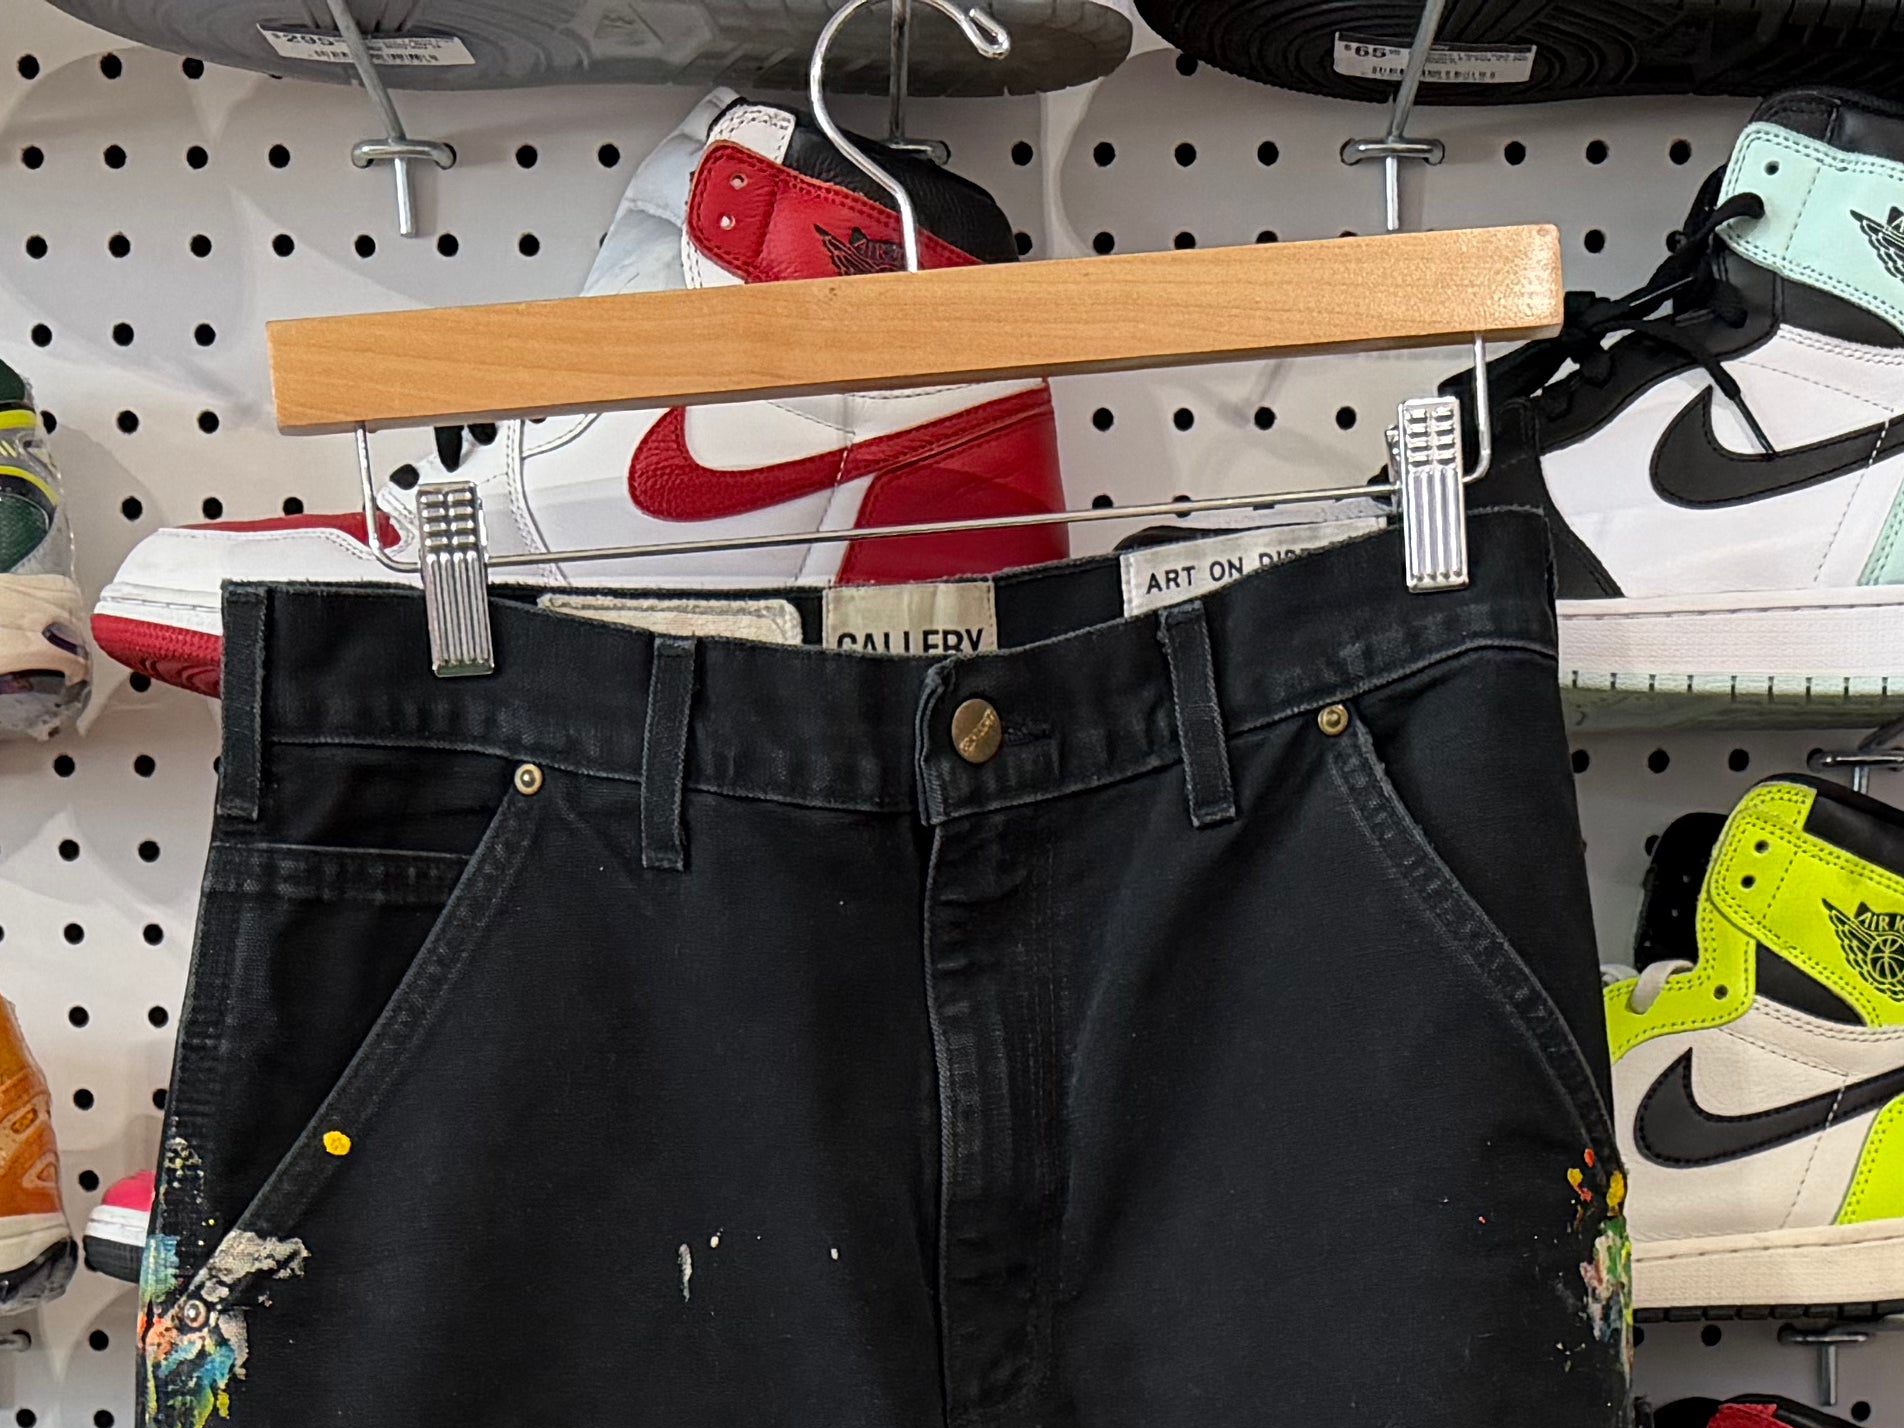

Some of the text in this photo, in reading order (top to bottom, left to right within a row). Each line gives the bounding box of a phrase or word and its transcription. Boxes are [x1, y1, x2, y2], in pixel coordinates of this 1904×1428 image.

[1146, 564, 1196, 594] ART
[1209, 556, 1244, 582] ON
[1857, 911, 1890, 932] AIR
